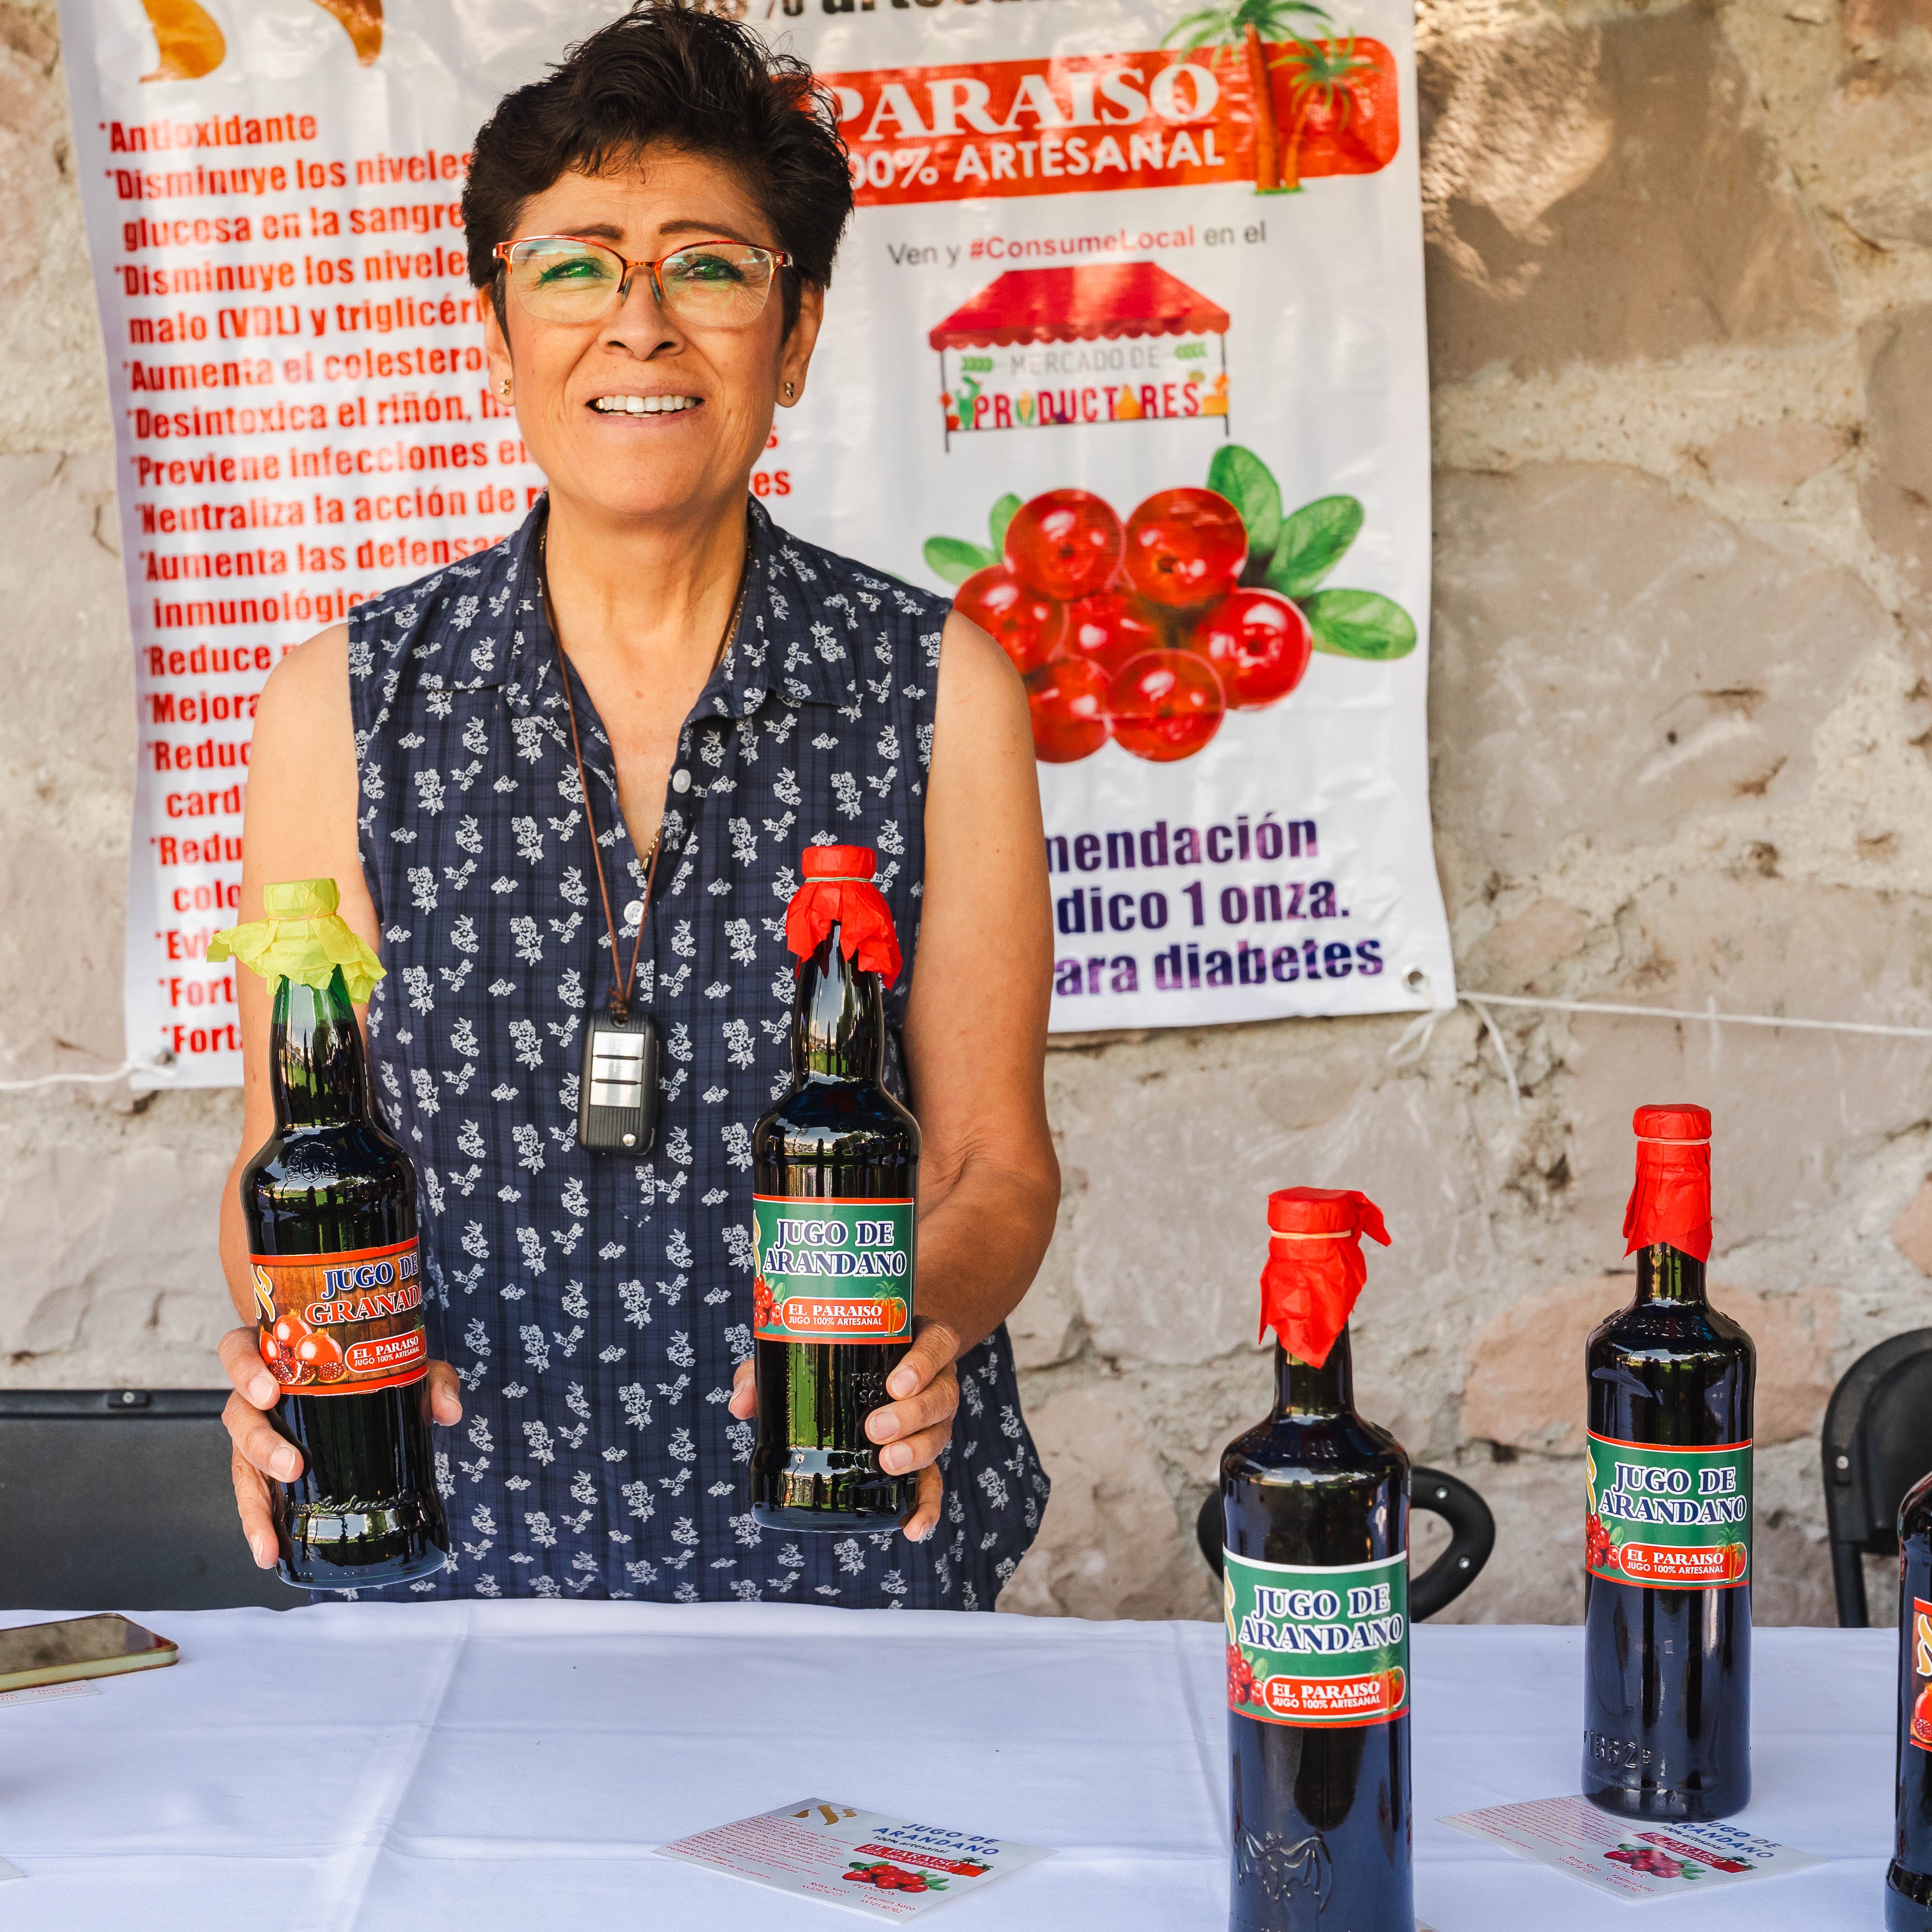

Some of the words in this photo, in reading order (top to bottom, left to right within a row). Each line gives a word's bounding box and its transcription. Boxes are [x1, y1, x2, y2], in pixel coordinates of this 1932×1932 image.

[953, 129, 1225, 183] ARTESANAL
[295, 159, 346, 189] los
[123, 217, 251, 253] glucosa
[262, 213, 300, 240] en
[310, 207, 339, 236] la
[350, 202, 464, 234] sangre
[886, 242, 938, 265] Ven
[946, 245, 961, 268] y
[971, 224, 1195, 260] #ConsumeLocal
[1204, 226, 1235, 247] en
[1244, 219, 1266, 244] el
[305, 255, 354, 286] los
[129, 311, 207, 344] malo
[310, 309, 325, 337] y
[284, 351, 313, 383] el
[1011, 347, 1124, 376] MERCADO
[1130, 346, 1158, 368] DE
[338, 396, 366, 427] el
[290, 441, 488, 478] infecciones
[315, 494, 343, 524] la
[354, 484, 466, 522] acción
[477, 483, 515, 514] de
[297, 543, 346, 572] las
[1183, 880, 1204, 926] 1
[1221, 880, 1349, 925] onza.
[1154, 938, 1384, 991] diabetes
[774, 1219, 849, 1249] JUGO
[855, 1221, 894, 1246] DE
[322, 1262, 393, 1300] JUGO
[399, 1252, 418, 1281] DE
[763, 1248, 907, 1277] ARANDANO
[788, 1304, 807, 1315] EL
[813, 1305, 882, 1317] PARAISO
[353, 1349, 371, 1359] EL
[375, 1335, 419, 1355] PARAISO
[354, 1358, 375, 1366] JUGO
[395, 1347, 420, 1360] ARTESANAL
[1611, 1461, 1691, 1495] JUGO
[1698, 1466, 1736, 1495] DE
[1598, 1489, 1747, 1525] ARANDANO
[1627, 1549, 1647, 1562] EL
[1653, 1553, 1724, 1565] PARAISO
[1627, 1562, 1650, 1571] JUGO
[1654, 1565, 1676, 1574] 100%
[1678, 1565, 1724, 1574] ARTESANAL
[1252, 1584, 1340, 1620] JUGO
[1347, 1582, 1390, 1618] DE
[1238, 1614, 1403, 1655] ARANDANO
[1272, 1682, 1295, 1698] EL
[1301, 1682, 1380, 1699] PARAISO
[1273, 1696, 1300, 1708] JUGO
[1303, 1699, 1328, 1709] 100%
[1330, 1695, 1380, 1708] ARTESANAL
[872, 1827, 999, 1855] ARANDANO
[901, 1842, 949, 1853] artesanal
[902, 1824, 962, 1838] JUGO
[968, 1836, 999, 1845] DE
[1682, 1834, 1726, 1850] artesanal
[1755, 1838, 1782, 1848] DE
[888, 1849, 961, 1867] PARAISO
[905, 1859, 951, 1870] ARTESANAL
[1665, 1840, 1727, 1862] PARAISO
